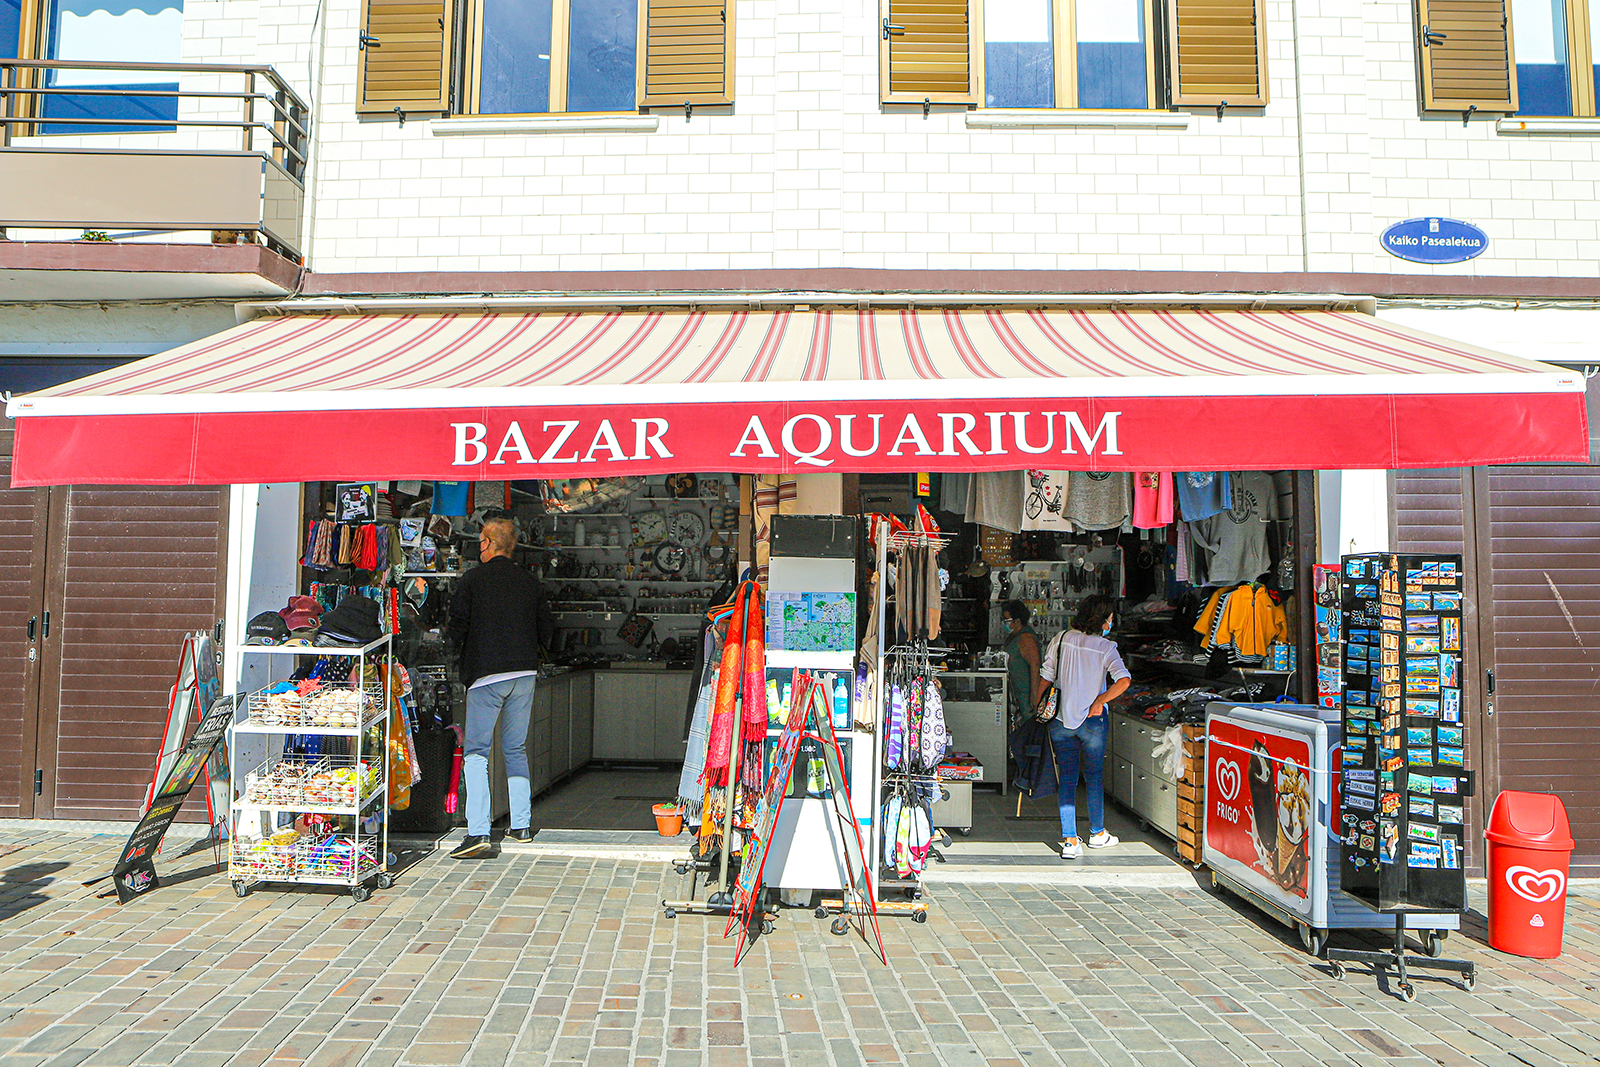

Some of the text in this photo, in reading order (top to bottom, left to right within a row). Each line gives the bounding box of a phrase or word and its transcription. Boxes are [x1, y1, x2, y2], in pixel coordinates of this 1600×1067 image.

[1389, 235, 1481, 247] Kaiko Pasealekua
[450, 410, 1124, 467] BAZAR AQUARIUM
[1217, 801, 1239, 824] FRIGO
